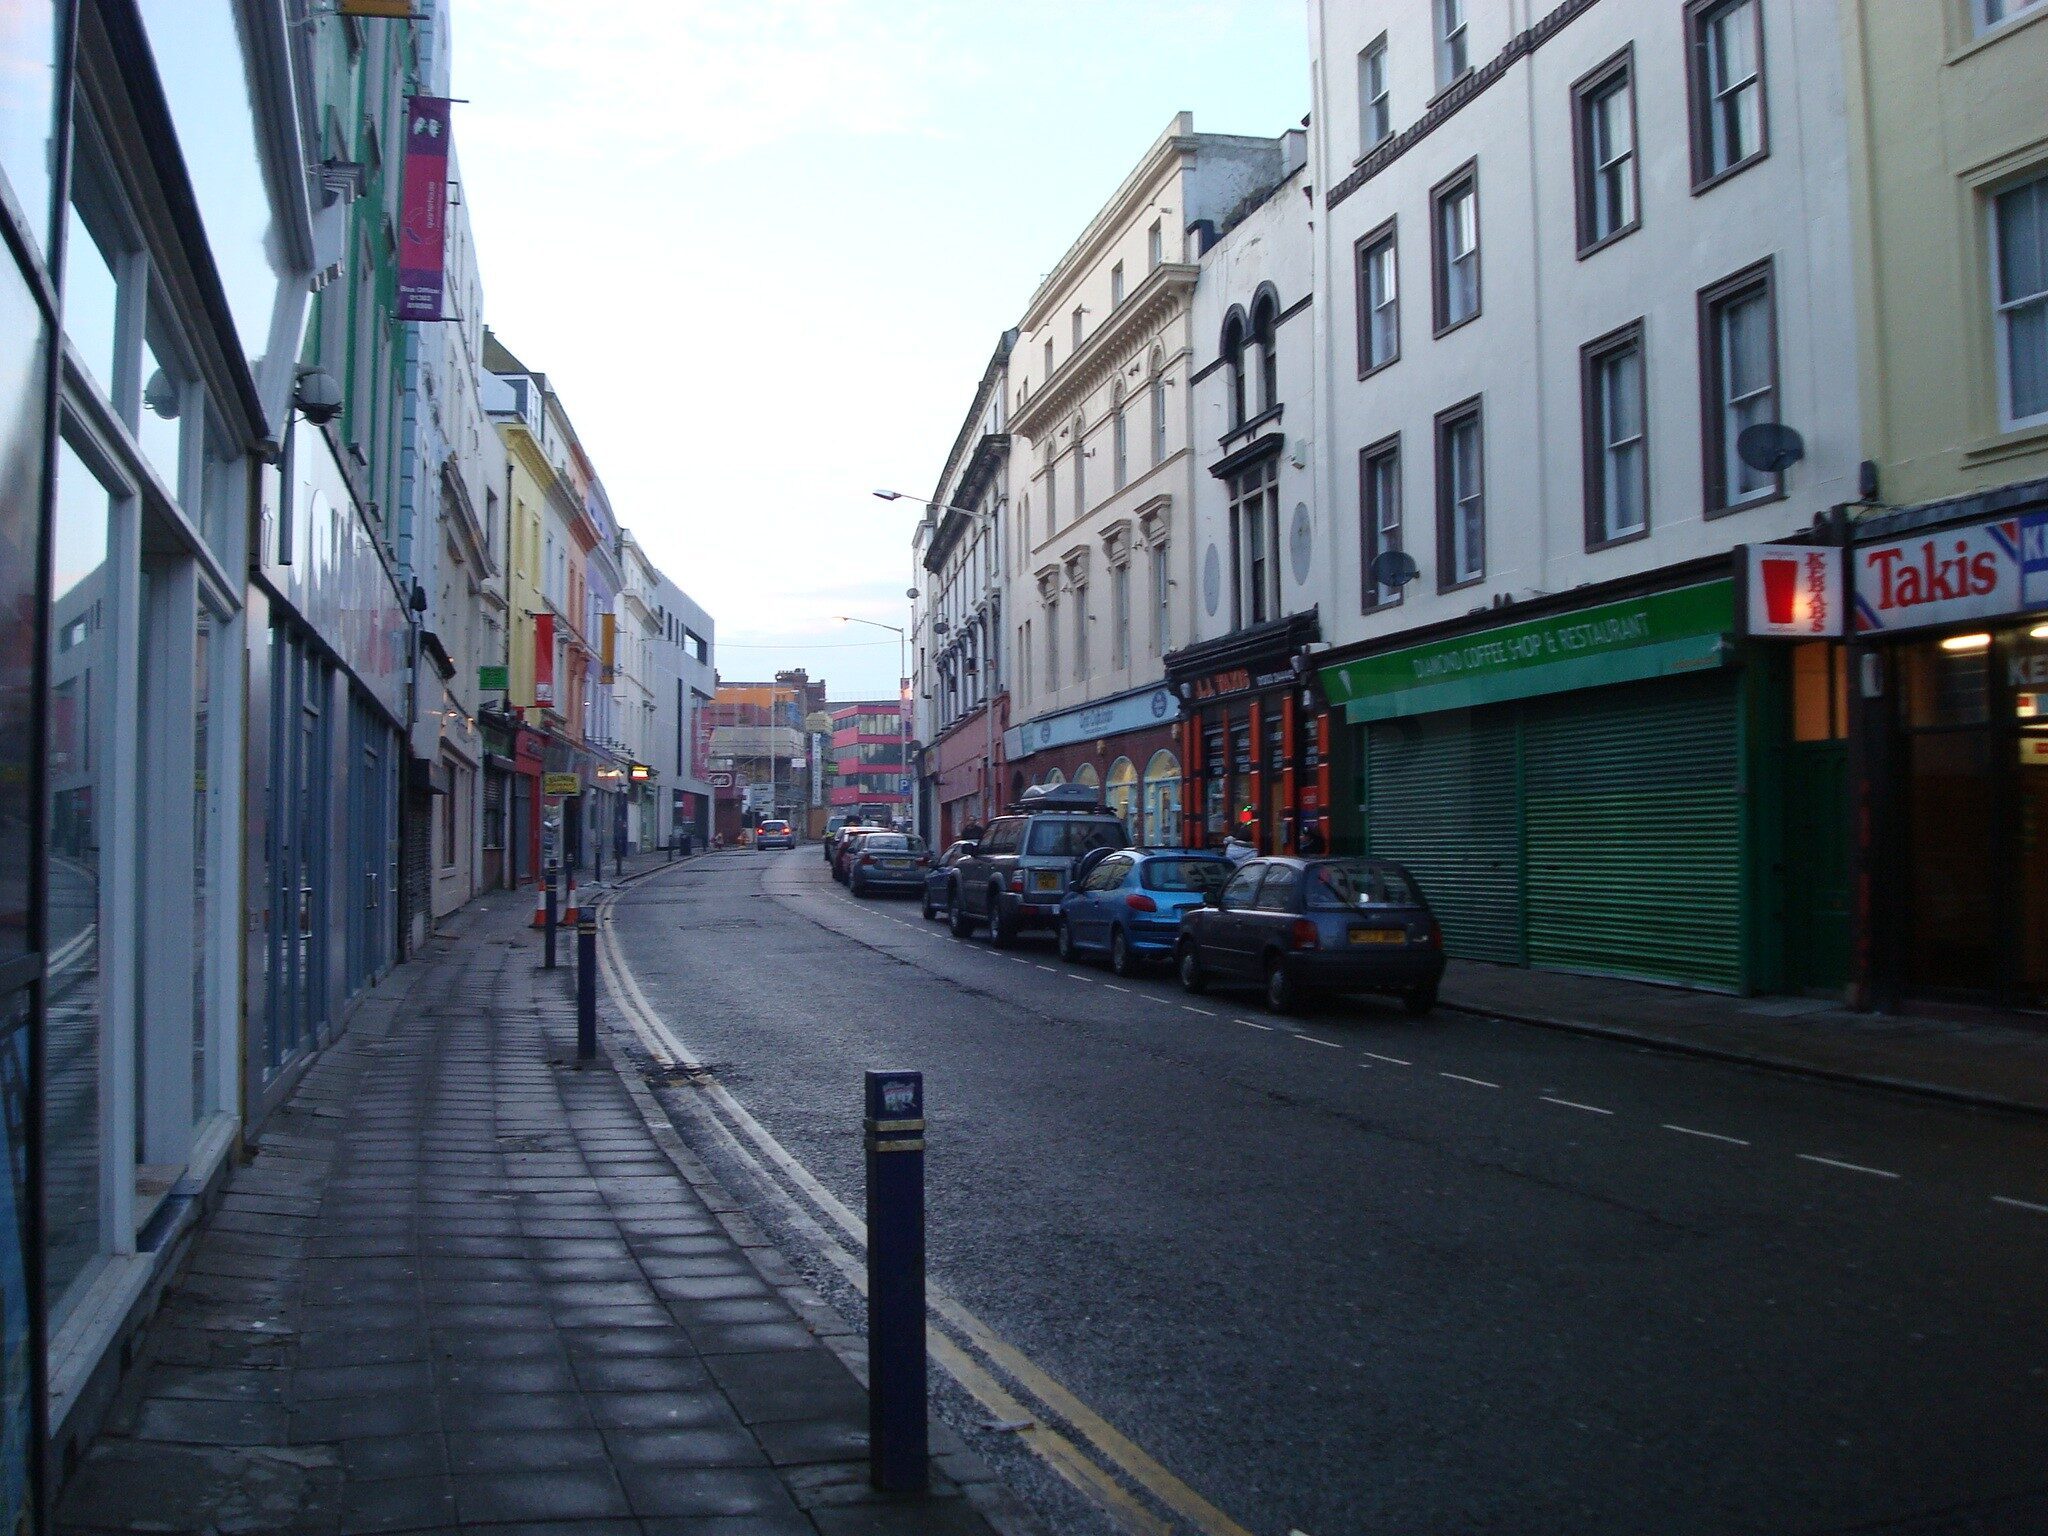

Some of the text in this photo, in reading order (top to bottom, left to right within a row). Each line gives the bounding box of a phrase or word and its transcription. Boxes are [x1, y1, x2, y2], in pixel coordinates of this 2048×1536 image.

[1867, 540, 1998, 611] Takis
[1462, 641, 1507, 669] COFFEE
[1508, 634, 1542, 660] SHOP
[1558, 612, 1648, 650] RESTAURANT
